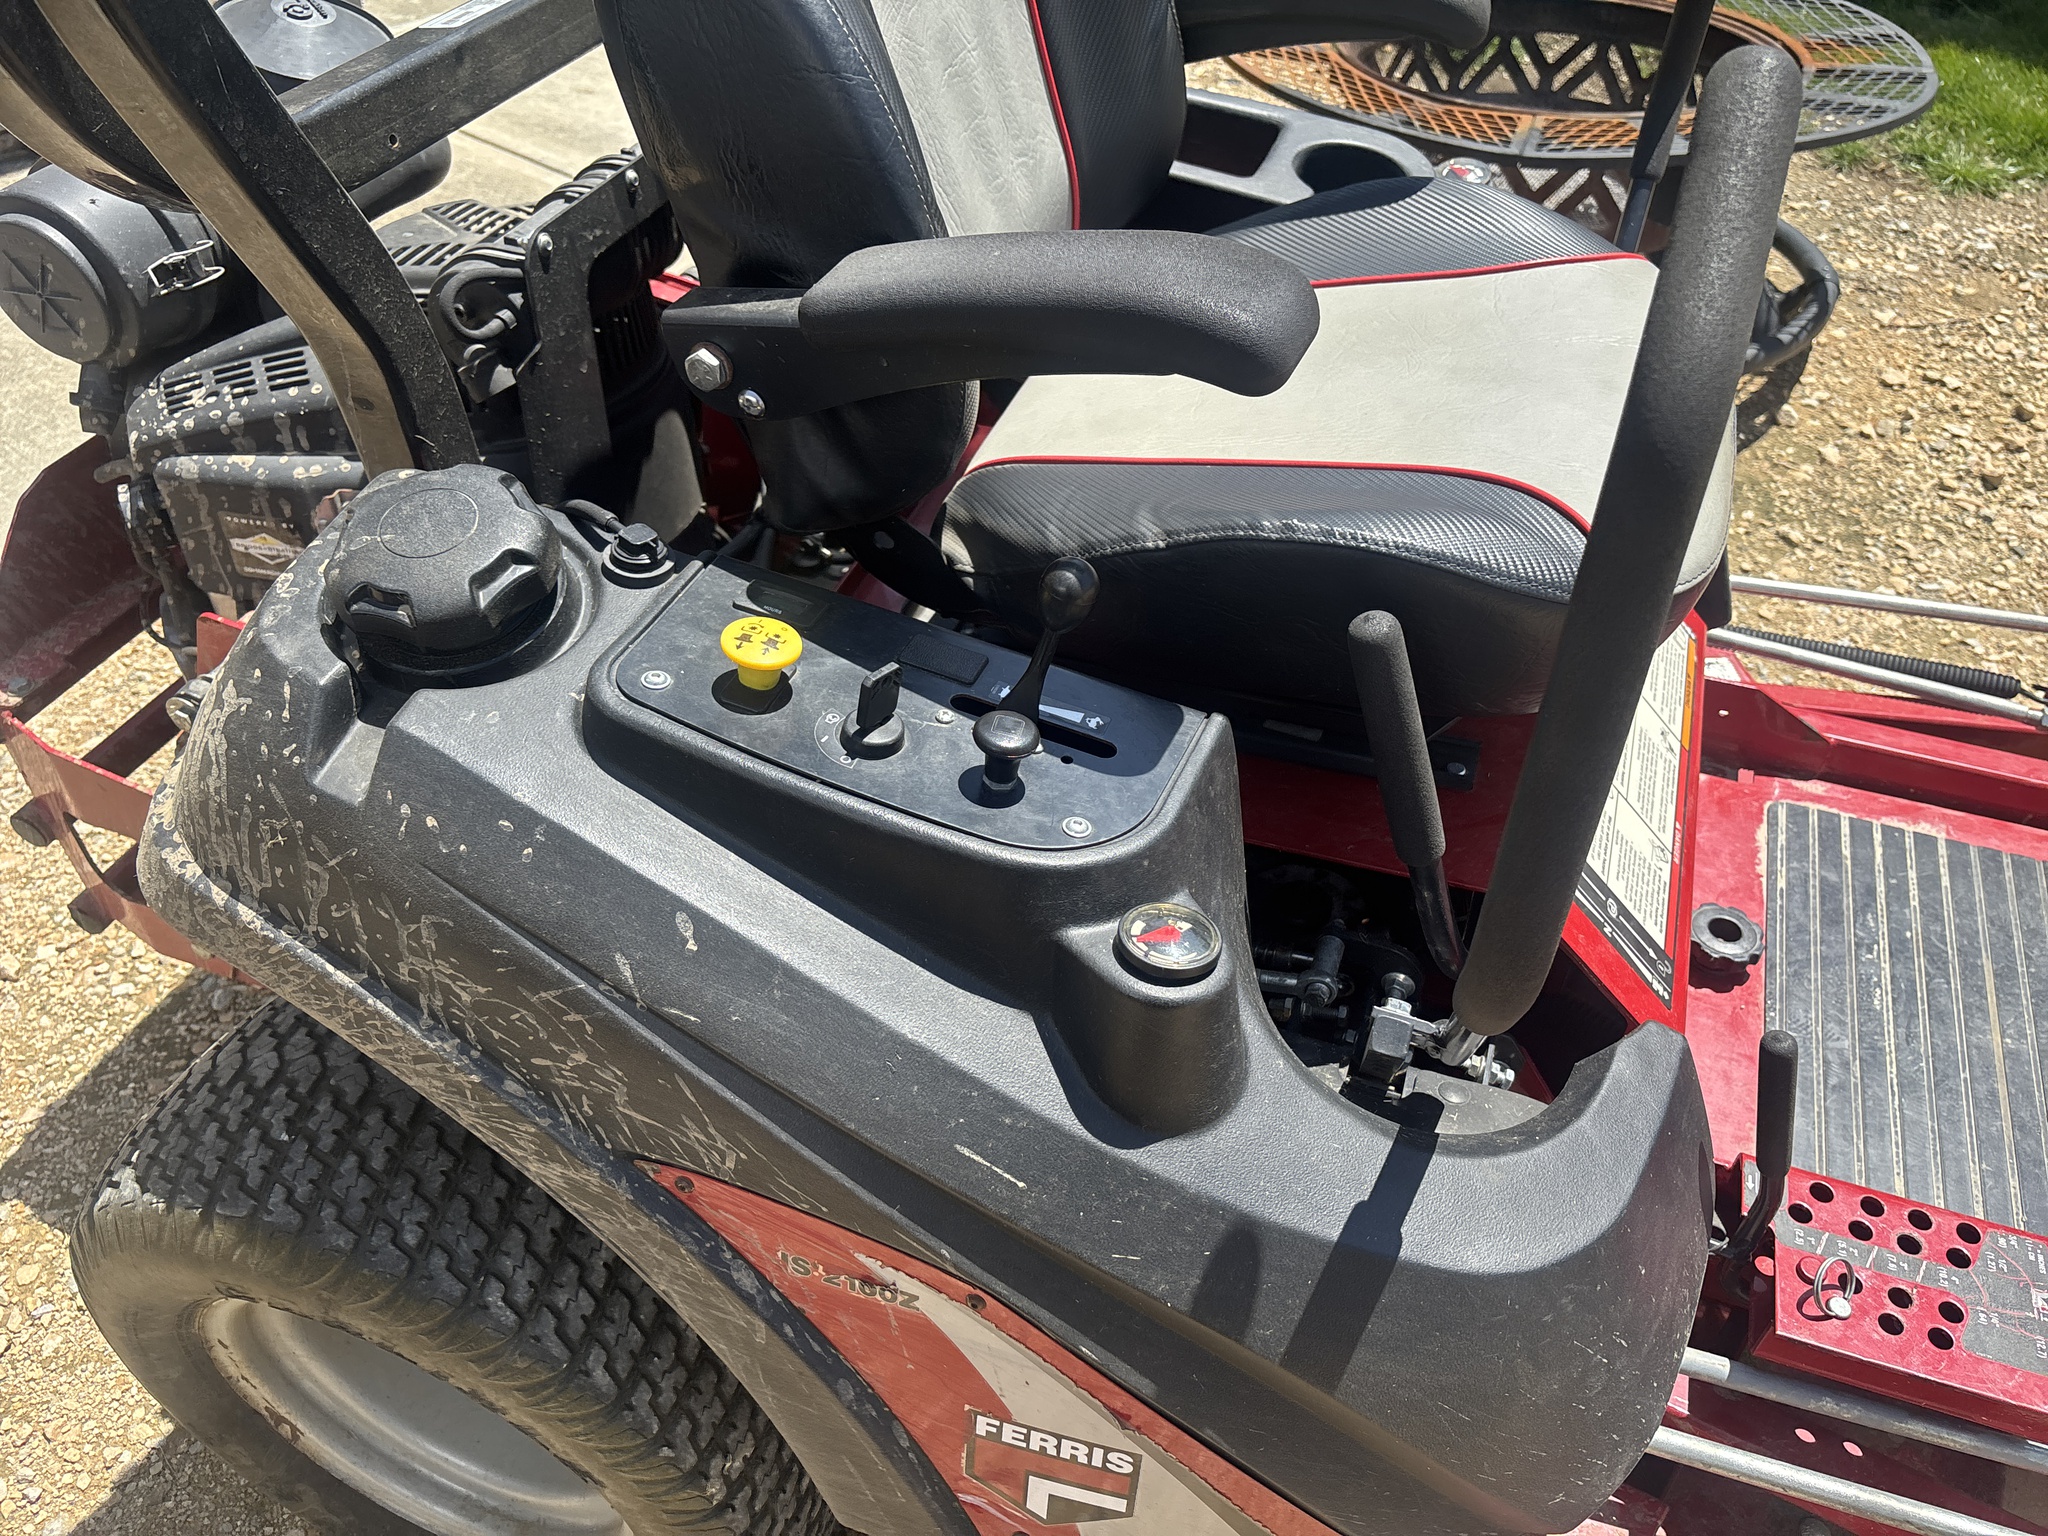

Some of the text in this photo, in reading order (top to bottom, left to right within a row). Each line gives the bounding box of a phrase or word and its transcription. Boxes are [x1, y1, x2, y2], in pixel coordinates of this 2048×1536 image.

[763, 605, 782, 615] HOURS
[1673, 829, 1682, 865] DANGER
[1836, 1239, 1847, 1257] (5.1)
[1886, 1254, 1897, 1271] (7.6)
[1984, 1251, 1997, 1272] (1.27)
[1936, 1266, 1948, 1287] (10.2)
[2034, 1336, 2047, 1358] (12.7)
[975, 1414, 1134, 1474] FERRIS
